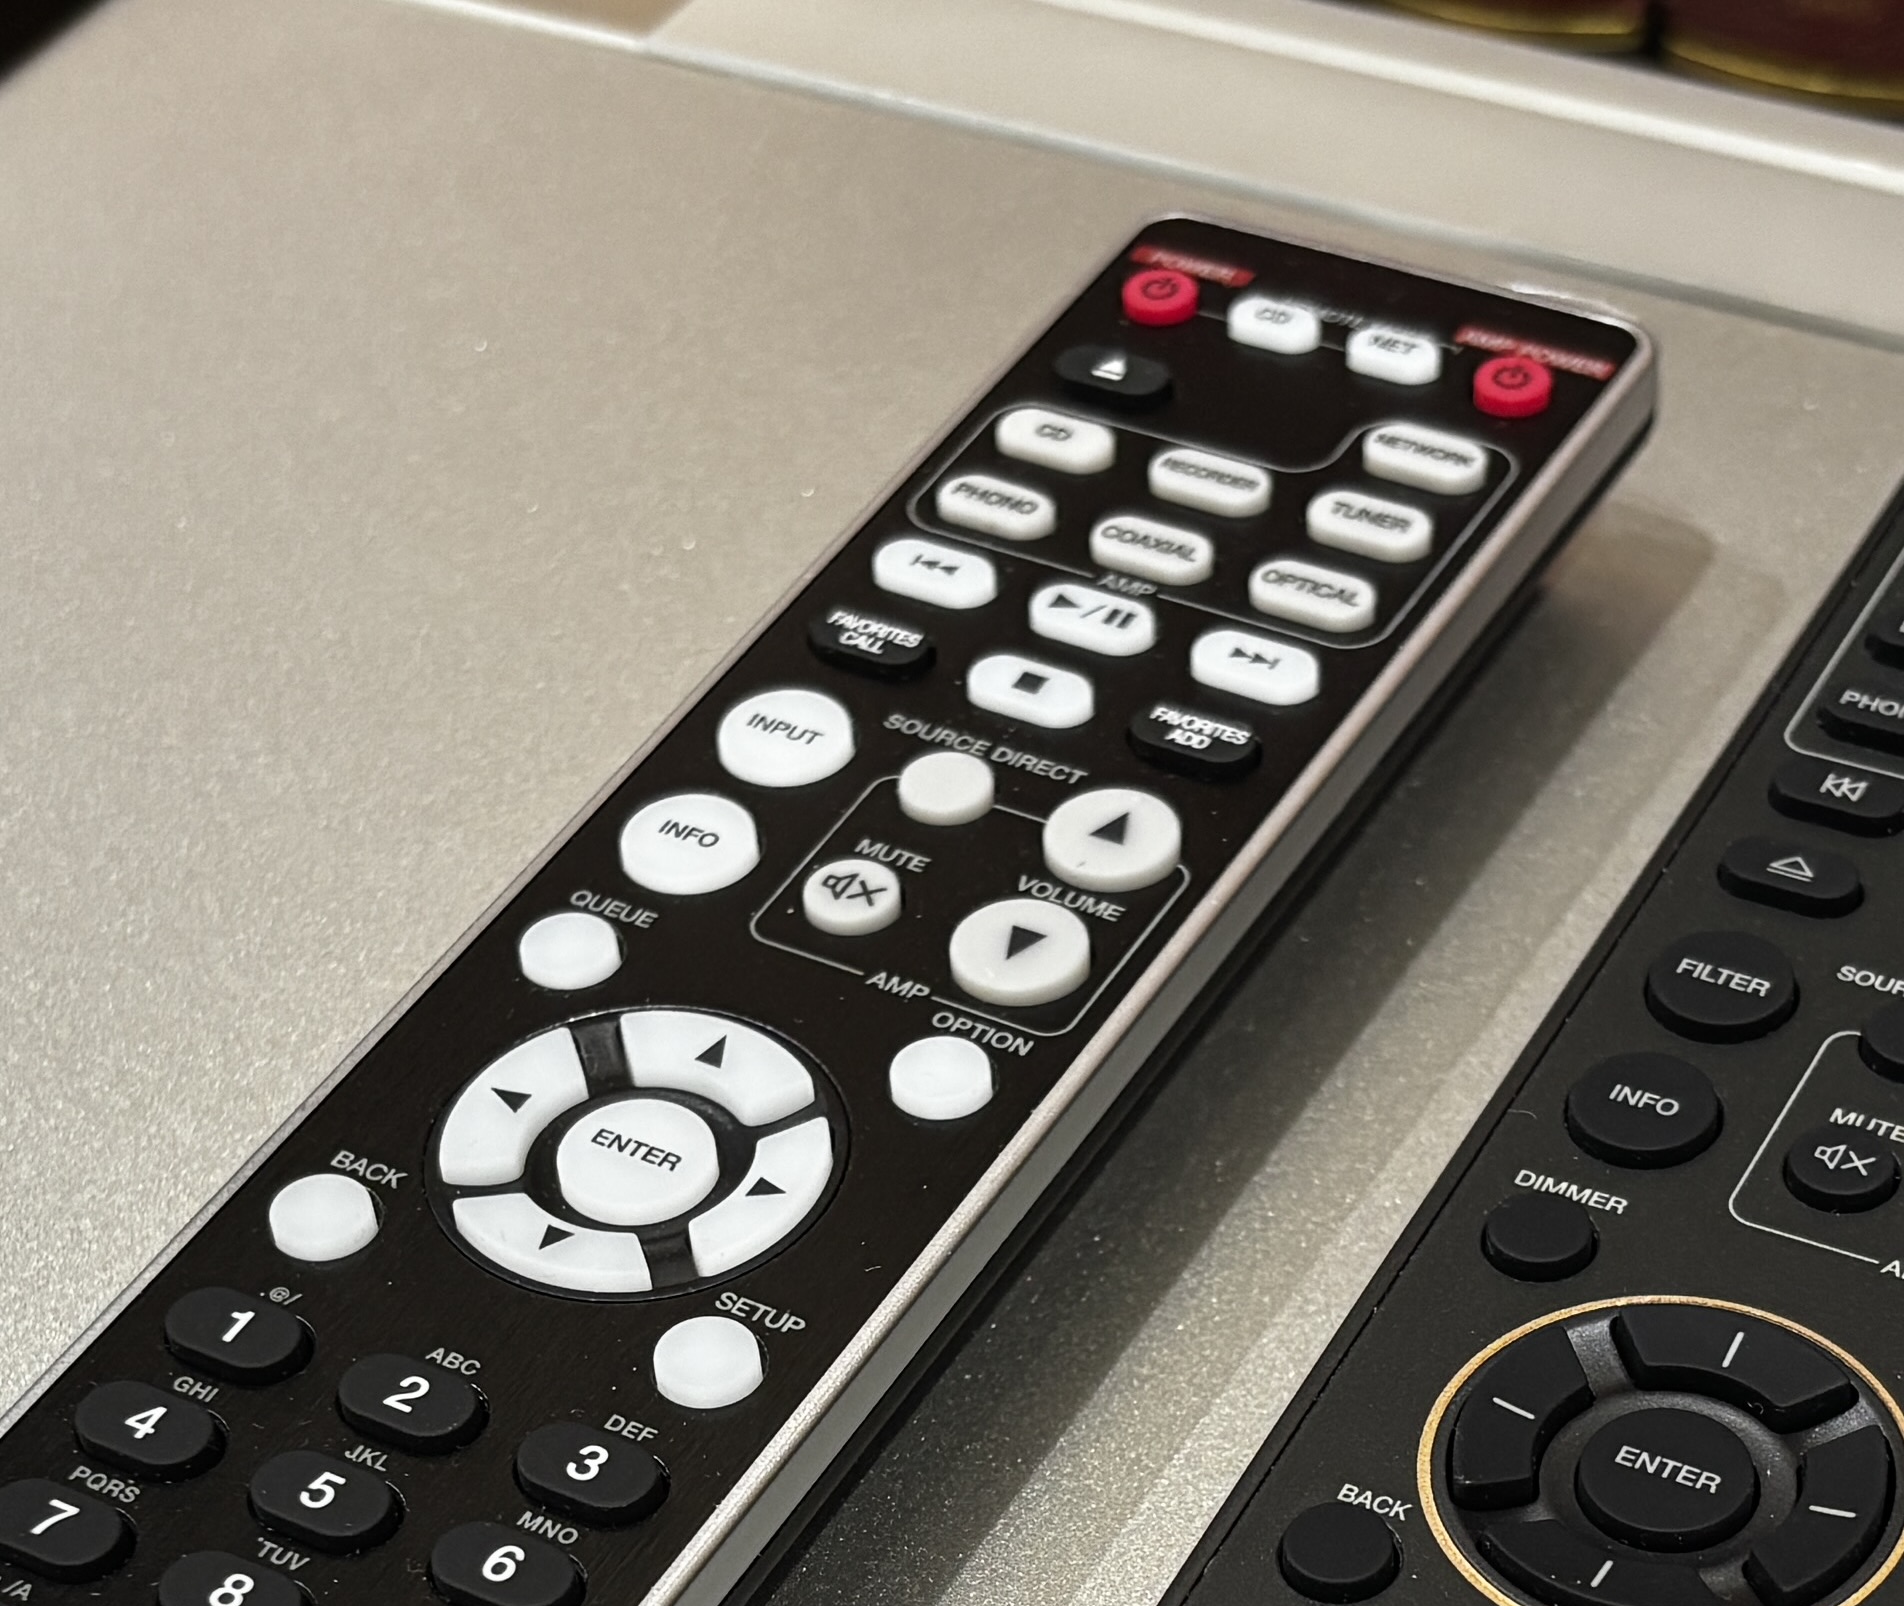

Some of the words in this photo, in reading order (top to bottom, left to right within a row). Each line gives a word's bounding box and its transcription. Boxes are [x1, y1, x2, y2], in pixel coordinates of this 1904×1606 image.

[1035, 424, 1071, 442] CD
[1373, 434, 1476, 468] NETWORK
[951, 481, 1039, 515] PHONO
[1332, 500, 1412, 533] TUNER
[1100, 525, 1197, 563] COAXIAL
[1097, 573, 1157, 597] AMP
[1261, 569, 1360, 607] OPTICAL
[828, 609, 923, 649] FAVORITES
[839, 630, 885, 656] CALL
[745, 712, 825, 747] INPUT
[1149, 704, 1253, 747] FAVORITES
[1165, 727, 1212, 751] ADD
[883, 713, 991, 757] SOURCE
[990, 744, 1089, 786] DIRECT
[657, 819, 720, 849] INFO
[853, 838, 931, 874] MUTE
[569, 889, 659, 930] QUEUE
[1016, 874, 1126, 923] VOLUME
[865, 970, 930, 1002] AMP
[1675, 956, 1772, 997] FILTER
[930, 1011, 1036, 1056] OPTION
[1608, 1082, 1680, 1117] INFO
[330, 1149, 409, 1191] BACK
[590, 1128, 683, 1175] ENTER
[1513, 1169, 1629, 1215] DIMMER
[221, 1309, 255, 1344] 1
[714, 1290, 807, 1337] SETUP
[425, 1346, 482, 1378] ABC
[172, 1375, 219, 1404] GHI
[382, 1375, 431, 1414] 2
[124, 1405, 169, 1441] 4
[604, 1414, 658, 1444] DEF
[344, 1442, 388, 1473] JKL
[565, 1444, 610, 1481] 3
[1614, 1445, 1723, 1495] ENTER
[68, 1466, 141, 1504] PQRS
[299, 1471, 346, 1509] 5
[1336, 1483, 1412, 1521] BACK
[30, 1501, 78, 1536] 7
[516, 1509, 579, 1546] MNO
[257, 1539, 310, 1572] TUV
[480, 1545, 525, 1584] 6
